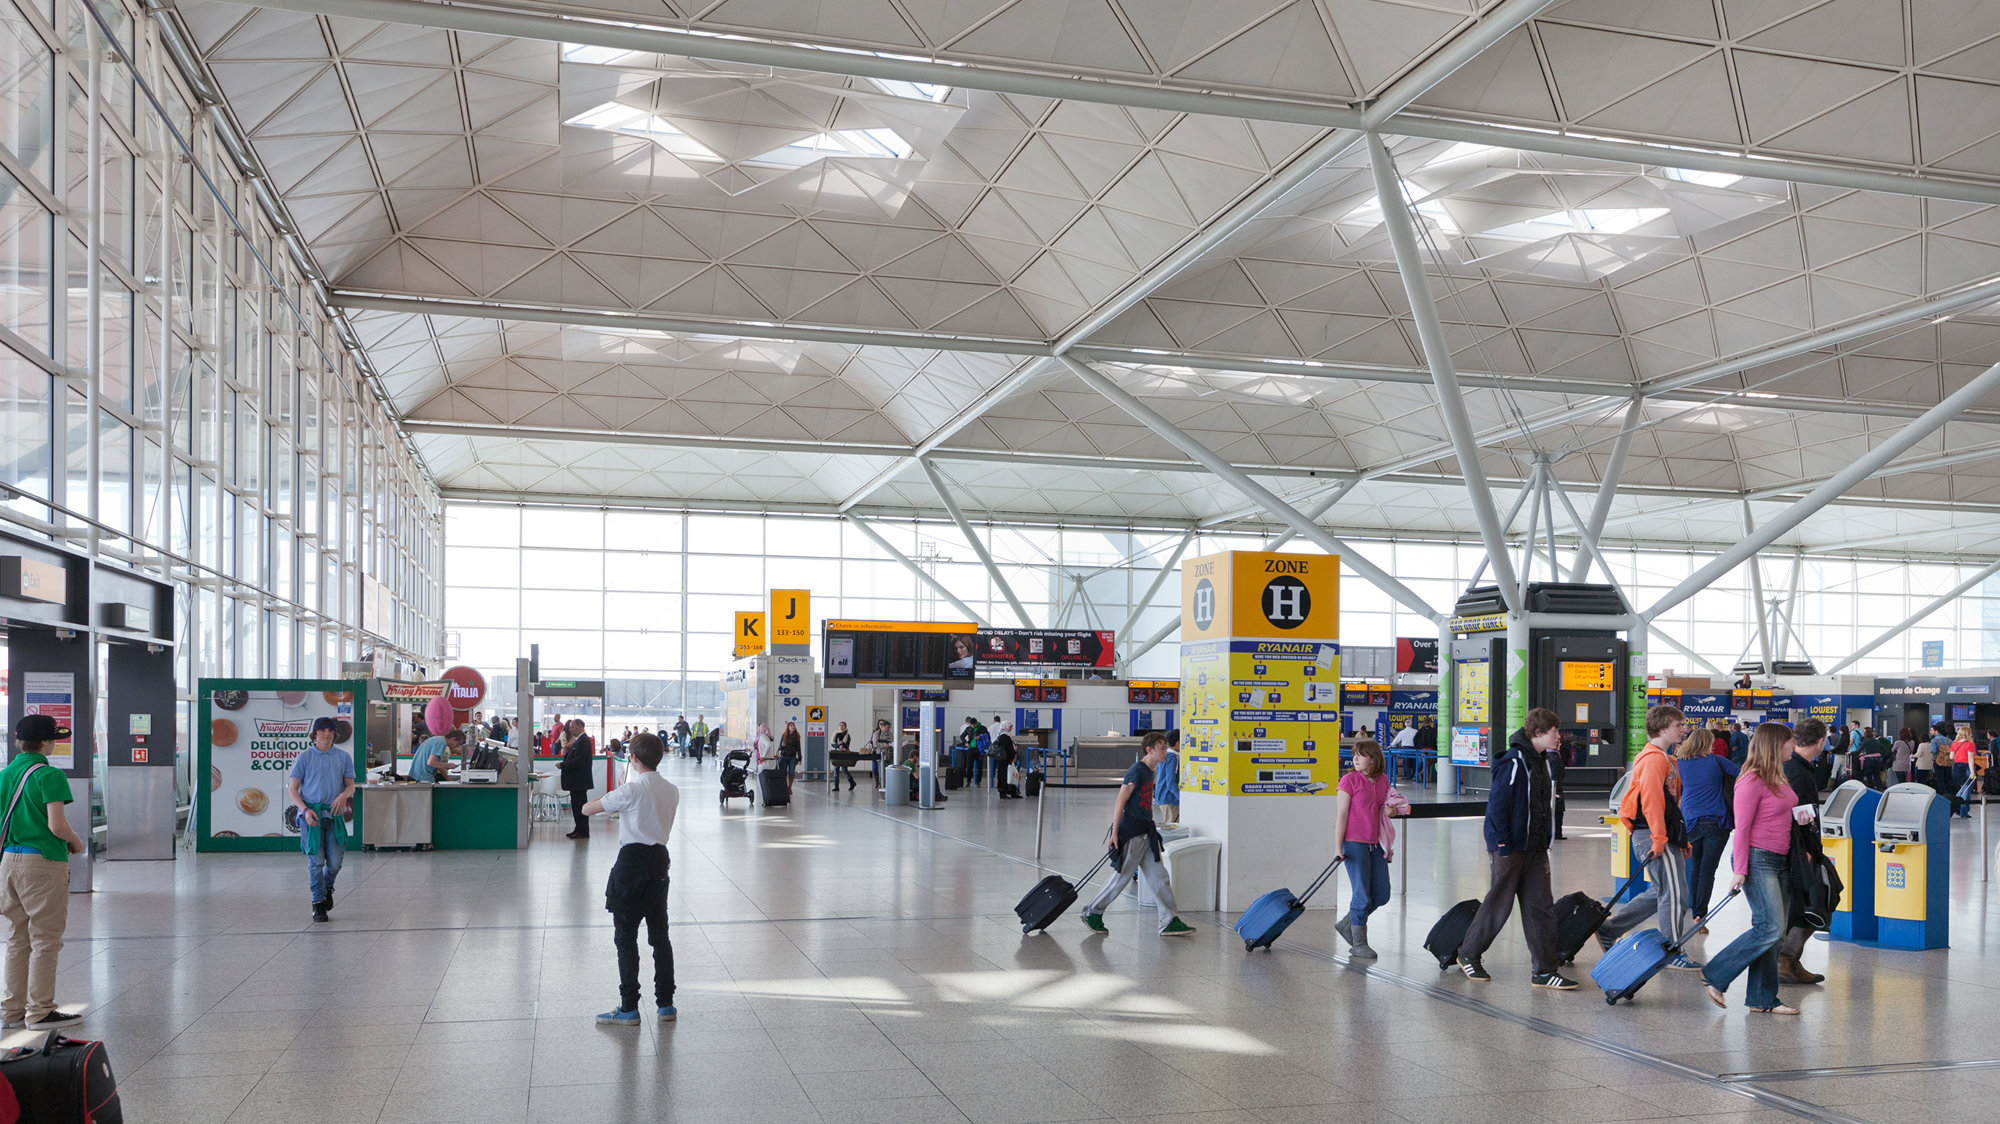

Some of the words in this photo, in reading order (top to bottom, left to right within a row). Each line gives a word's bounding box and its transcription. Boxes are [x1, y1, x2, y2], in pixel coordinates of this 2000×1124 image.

[1194, 561, 1215, 578] ZONE
[1264, 559, 1309, 574] ZONE
[1195, 587, 1213, 622] H
[1268, 585, 1305, 621] H
[785, 598, 796, 620] J
[743, 618, 759, 637] K
[1450, 620, 1464, 632] BAG
[1464, 618, 1481, 630] DROP
[1482, 616, 1499, 629] ZONE
[1257, 643, 1314, 653] RYANAIR
[1413, 640, 1432, 648] Over
[777, 656, 808, 664] Check-in
[778, 674, 800, 684] 133
[385, 684, 414, 697] Krispy
[414, 684, 444, 697] Kreme
[453, 687, 479, 698] ITALIA
[778, 685, 791, 695] to
[1879, 686, 1903, 695] Bureau
[1904, 686, 1913, 695] de
[1914, 686, 1941, 696] Change
[783, 697, 800, 707] 50
[1394, 702, 1438, 710] RYANAIR
[1683, 705, 1725, 713] RYANAIR
[1809, 706, 1838, 714] LOWEST
[260, 722, 284, 733] Krispy
[283, 722, 309, 733] Kreme
[251, 741, 314, 750] DELICIOUS
[251, 751, 299, 759] DOUGHN
[250, 760, 294, 771] &COF
